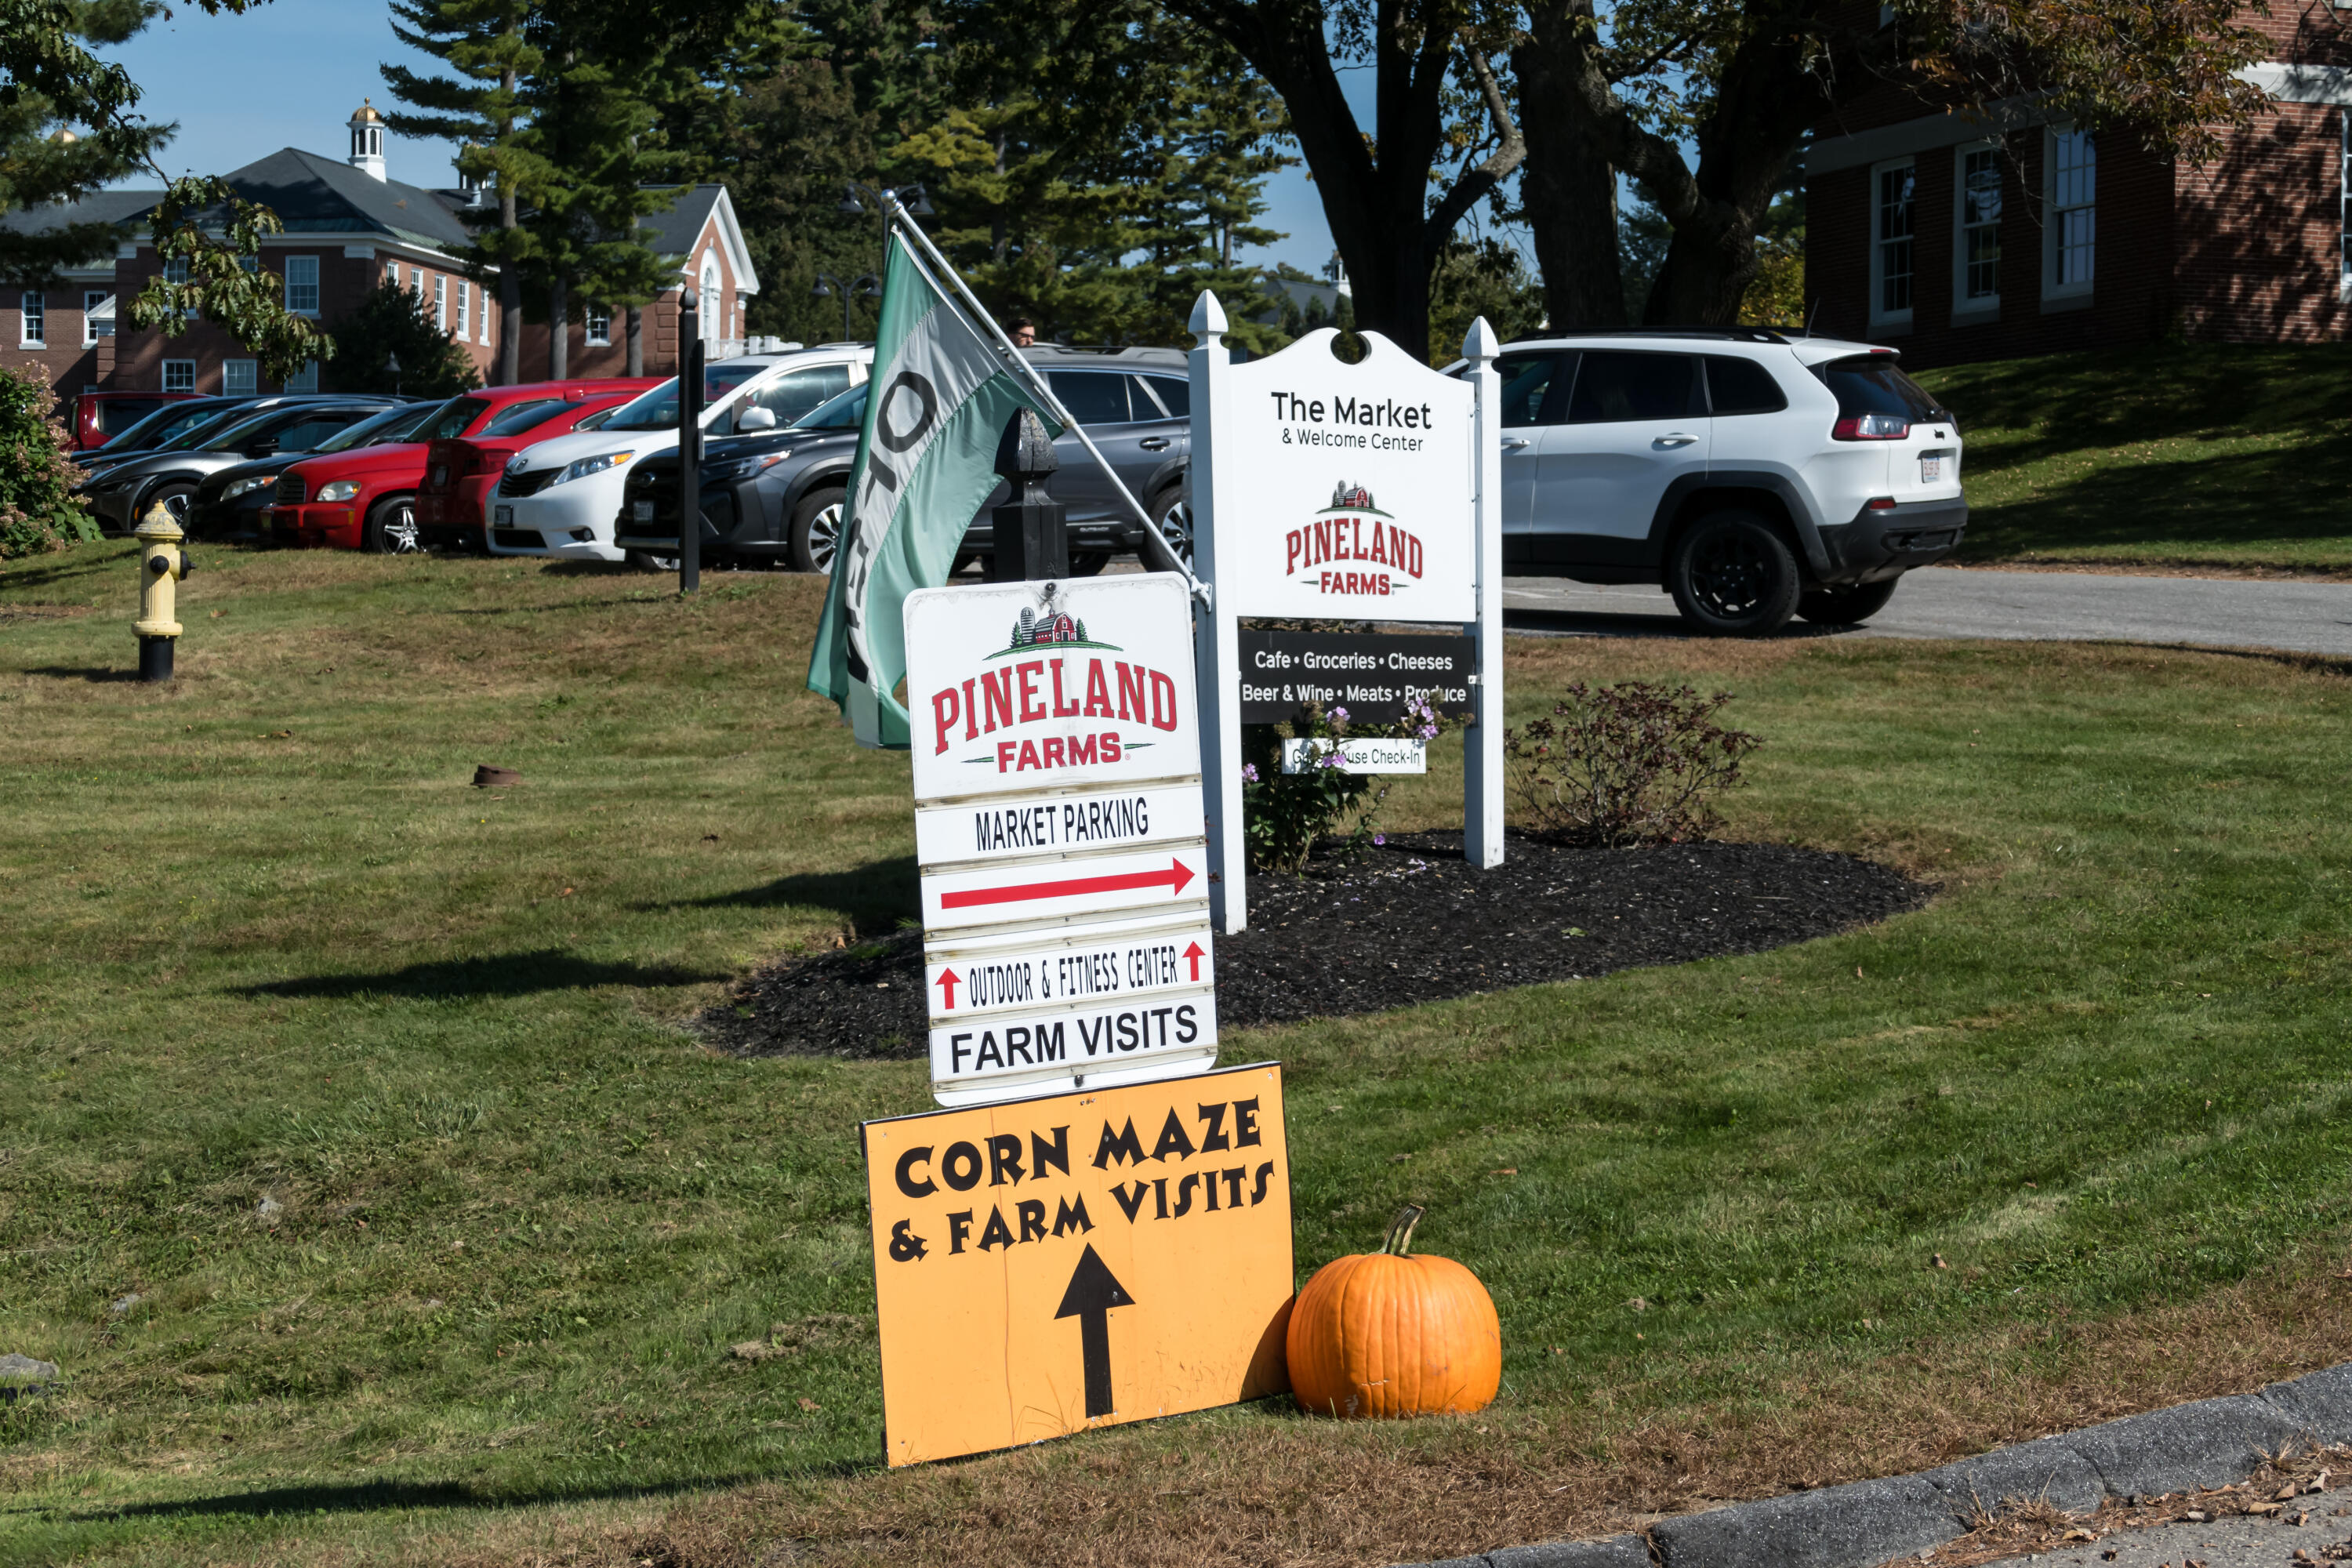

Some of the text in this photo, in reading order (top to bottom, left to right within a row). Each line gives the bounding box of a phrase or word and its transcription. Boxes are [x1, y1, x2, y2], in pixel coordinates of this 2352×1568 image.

[1271, 392, 1432, 430] The Market
[1282, 428, 1424, 452] & Welcome Center
[1287, 518, 1423, 580] PINELAND
[1321, 572, 1390, 596] FARMS
[1254, 651, 1453, 670] Cafe Groceries Cheeses
[932, 658, 1178, 756] PINELAND
[1242, 684, 1279, 702] Beer
[1282, 684, 1294, 702] &
[1296, 684, 1334, 702] Wine
[1346, 685, 1392, 702] Meats
[997, 732, 1122, 774] FARMS
[1371, 749, 1420, 764] Check-In
[975, 797, 1149, 851] MARKET PARKING
[970, 945, 1178, 1007] OUTDOOR & FITNESS CENTER
[951, 1004, 1198, 1073] FARM VISITS
[895, 1094, 1261, 1199] CORN MAZE
[888, 1159, 1276, 1262] & FARM VISITS
